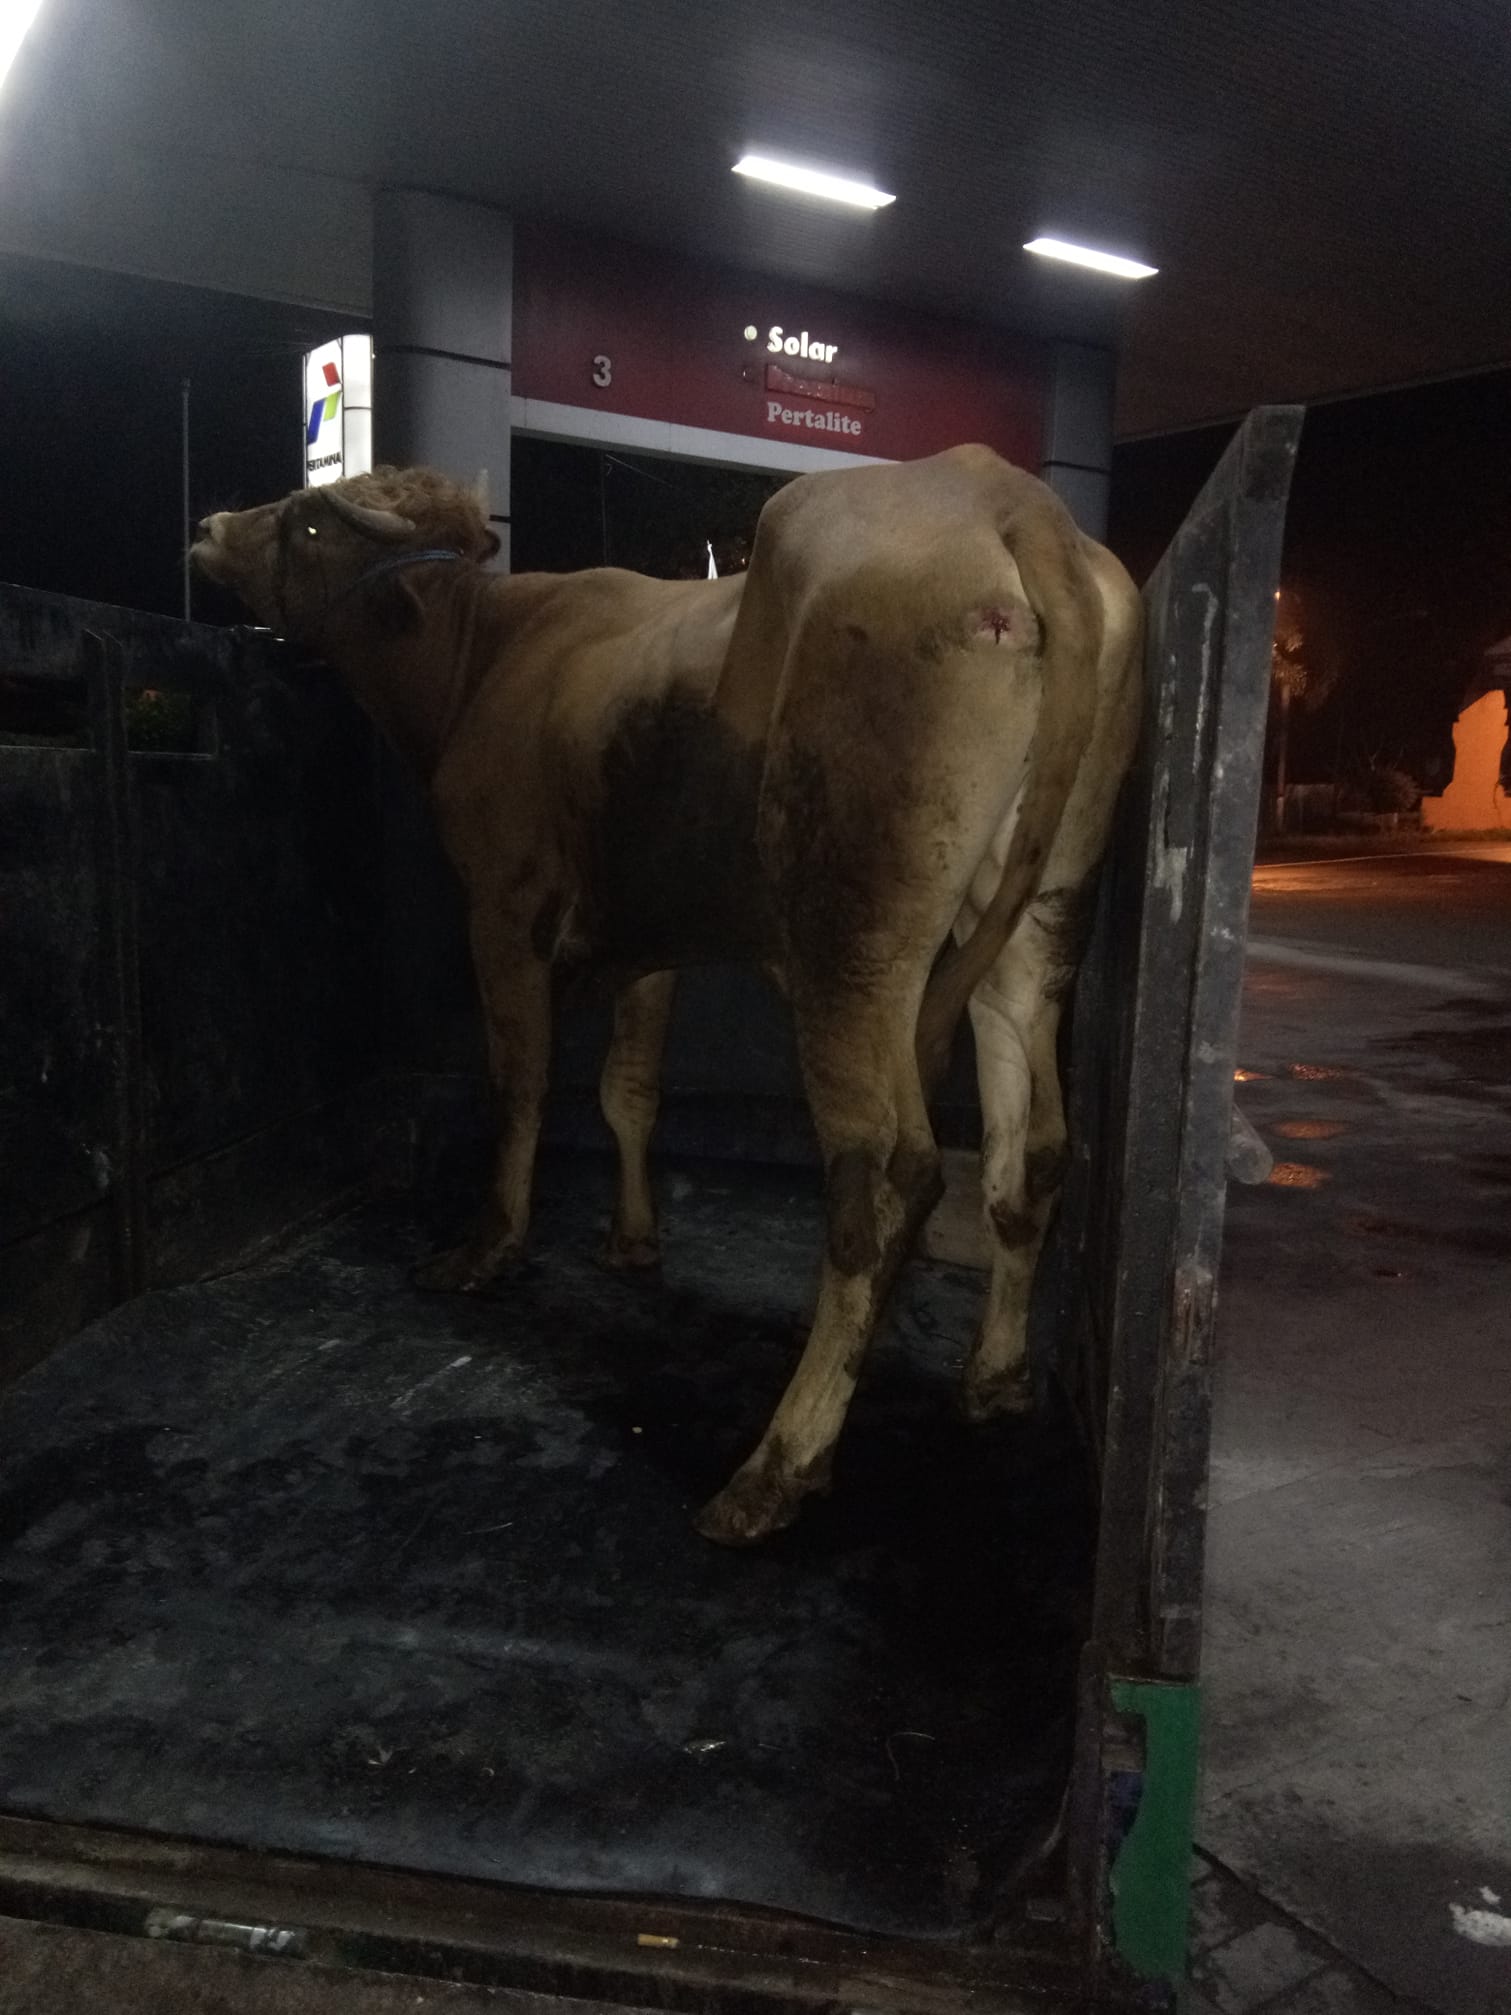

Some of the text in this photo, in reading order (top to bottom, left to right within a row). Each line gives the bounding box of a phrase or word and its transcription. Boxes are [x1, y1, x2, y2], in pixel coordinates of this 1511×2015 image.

[766, 326, 838, 363] Solar
[593, 356, 612, 387] 3
[766, 402, 862, 436] Pertalite
